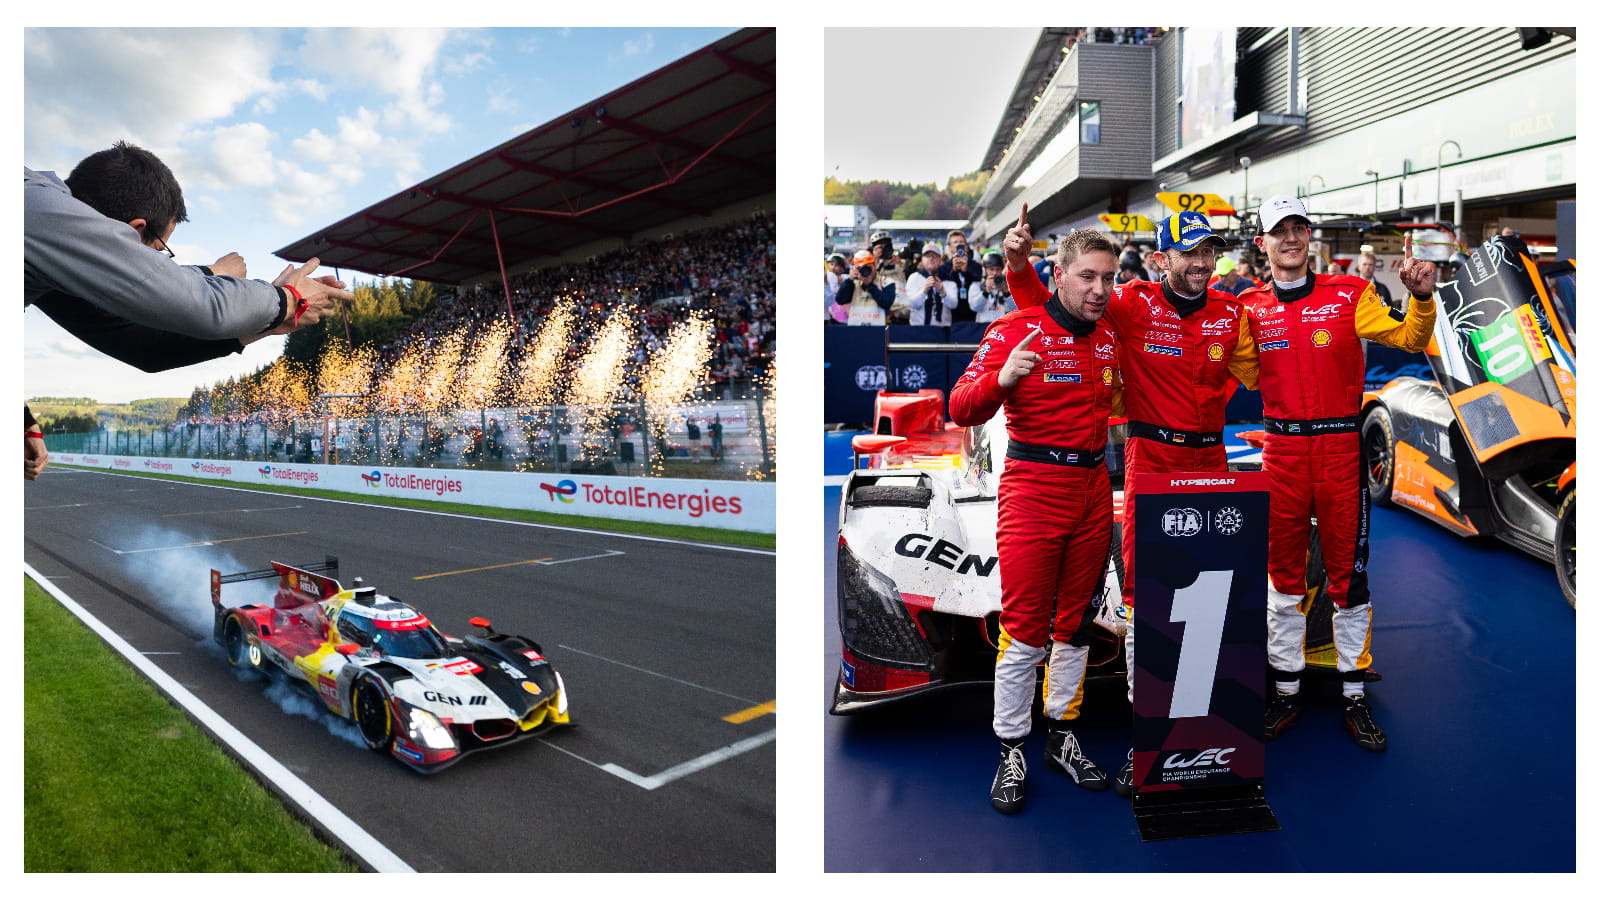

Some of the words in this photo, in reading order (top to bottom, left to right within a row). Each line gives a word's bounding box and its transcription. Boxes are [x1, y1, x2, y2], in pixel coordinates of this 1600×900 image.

[1509, 112, 1555, 138] ROLEX
[1178, 194, 1205, 213] 92
[1120, 215, 1138, 231] 91
[1519, 313, 1543, 352] DHL
[1478, 322, 1526, 378] 10
[272, 467, 319, 485] TotalEnergies
[384, 473, 463, 496] TotalEnergies
[1170, 478, 1236, 487] HYPERCAR
[581, 483, 743, 518] TotalEnergies
[895, 533, 999, 578] GEN
[1168, 569, 1234, 719] 1
[424, 691, 463, 706] GEN
[1163, 747, 1237, 769] WEC
[1163, 774, 1207, 782] CHAMPIONSHIP
[1196, 767, 1231, 775] ENDURANCE
